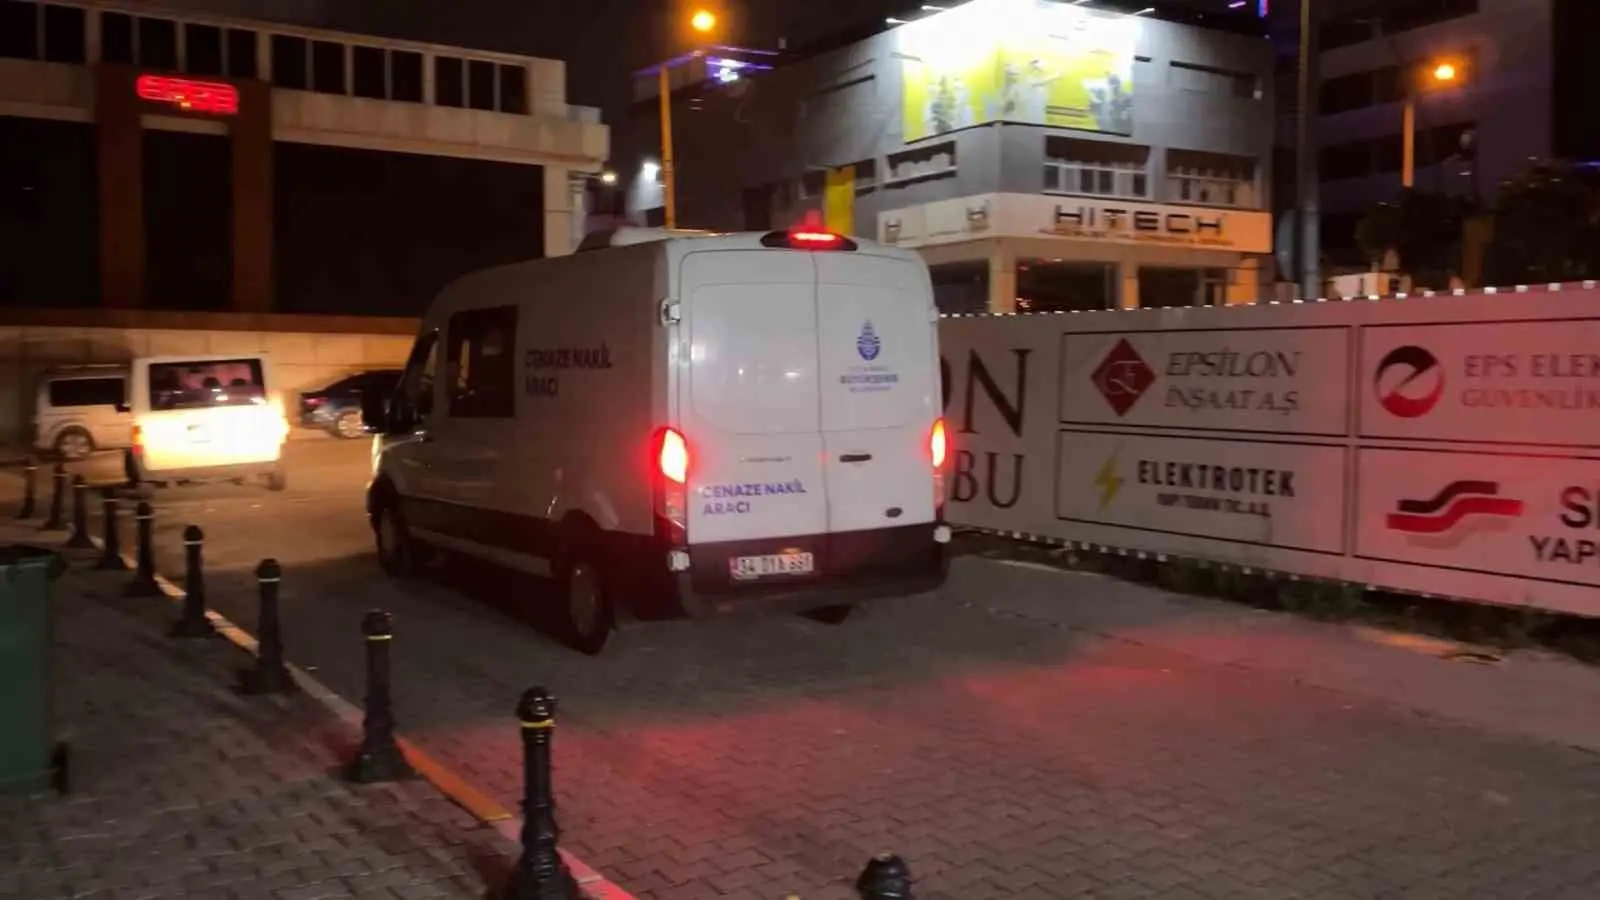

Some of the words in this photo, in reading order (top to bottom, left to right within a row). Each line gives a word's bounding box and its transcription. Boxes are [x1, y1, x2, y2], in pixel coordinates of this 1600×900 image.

[1054, 205, 1222, 236] HITECH
[1464, 354, 1518, 377] EPS
[702, 484, 762, 498] CENAZE
[764, 478, 808, 494] NAKİL
[1138, 460, 1295, 497] ELEKTROTEK
[703, 501, 750, 515] ARACI
[1560, 486, 1600, 529] S
